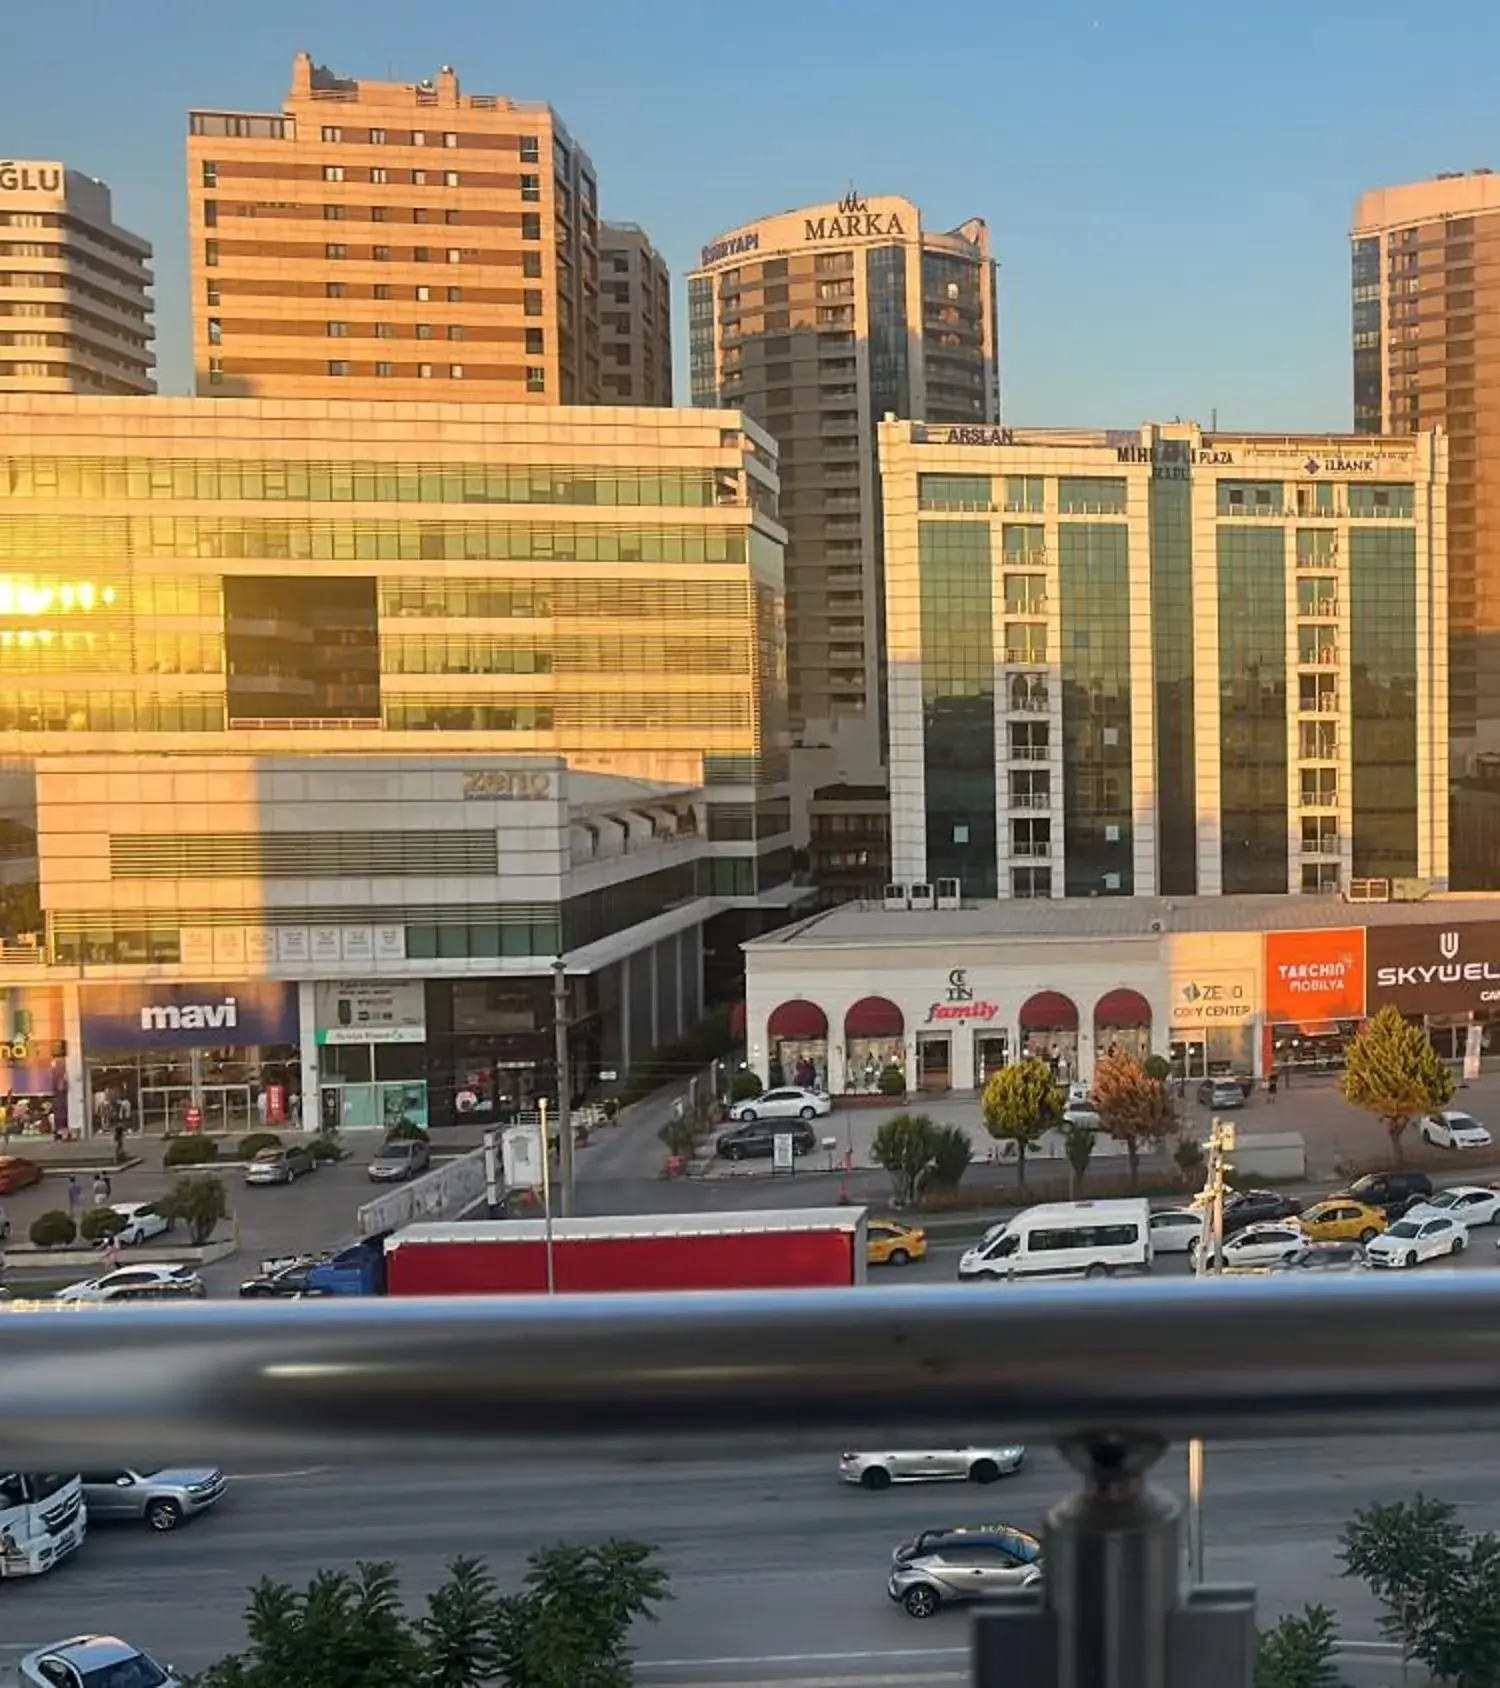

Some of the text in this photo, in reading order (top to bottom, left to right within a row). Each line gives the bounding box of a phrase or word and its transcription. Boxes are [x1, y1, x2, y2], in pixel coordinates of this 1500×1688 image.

[804, 212, 905, 241] MARKA
[948, 428, 1014, 446] ARSLAN
[1199, 451, 1234, 465] PLAZA
[1202, 984, 1243, 1000] ZEO
[141, 998, 237, 1030] mavi
[924, 1001, 999, 1023] family
[1205, 1004, 1251, 1018] CENTER
